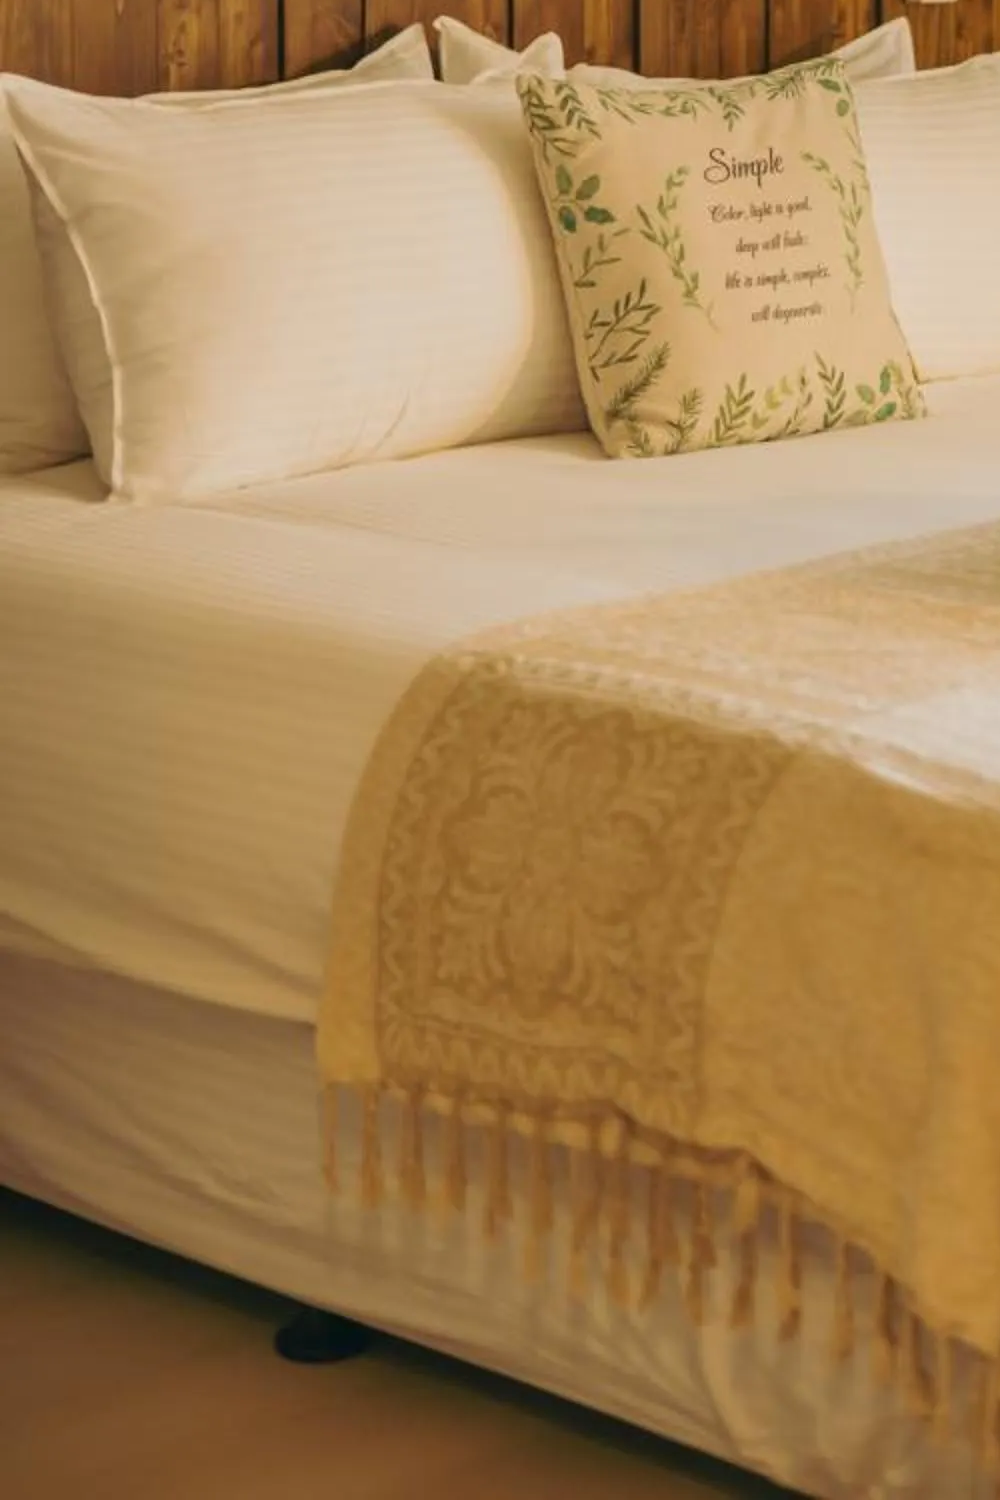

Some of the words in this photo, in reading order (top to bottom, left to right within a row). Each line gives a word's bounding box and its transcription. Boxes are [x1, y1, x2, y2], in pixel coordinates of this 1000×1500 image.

[703, 147, 784, 188] Simple
[751, 202, 773, 224] light
[775, 203, 784, 216] is
[735, 236, 759, 259] deep
[761, 232, 781, 250] will
[725, 270, 741, 290] life
